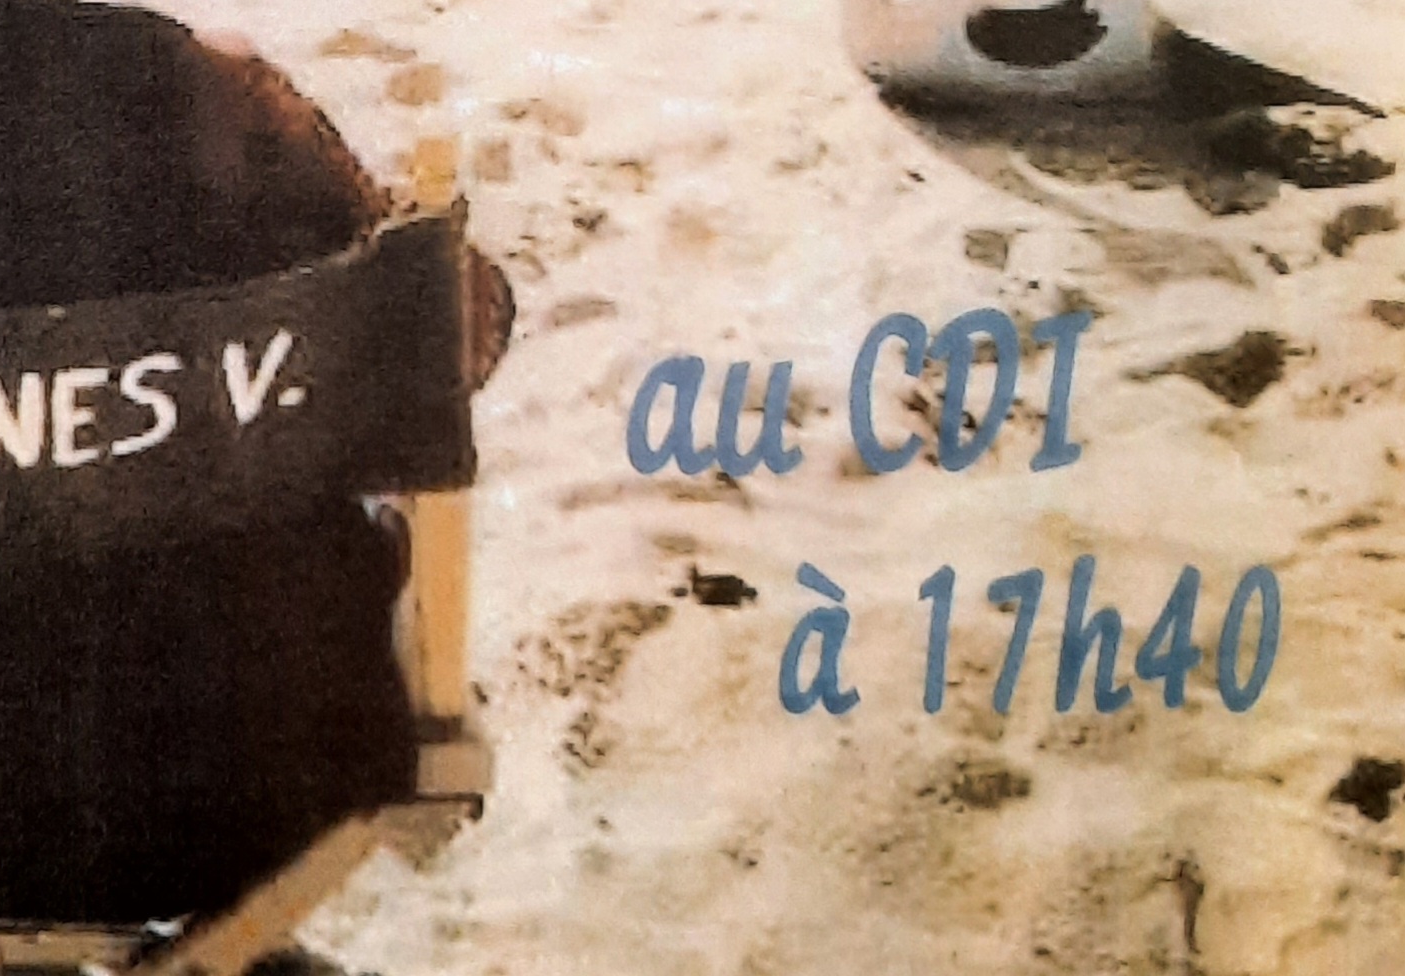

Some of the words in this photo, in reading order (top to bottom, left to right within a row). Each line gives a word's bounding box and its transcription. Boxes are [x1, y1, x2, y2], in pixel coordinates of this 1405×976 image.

[222, 327, 307, 426] V.
[626, 355, 803, 477] au
[849, 307, 1093, 473] CDI
[778, 561, 862, 715] à
[918, 553, 1282, 715] 17h40
